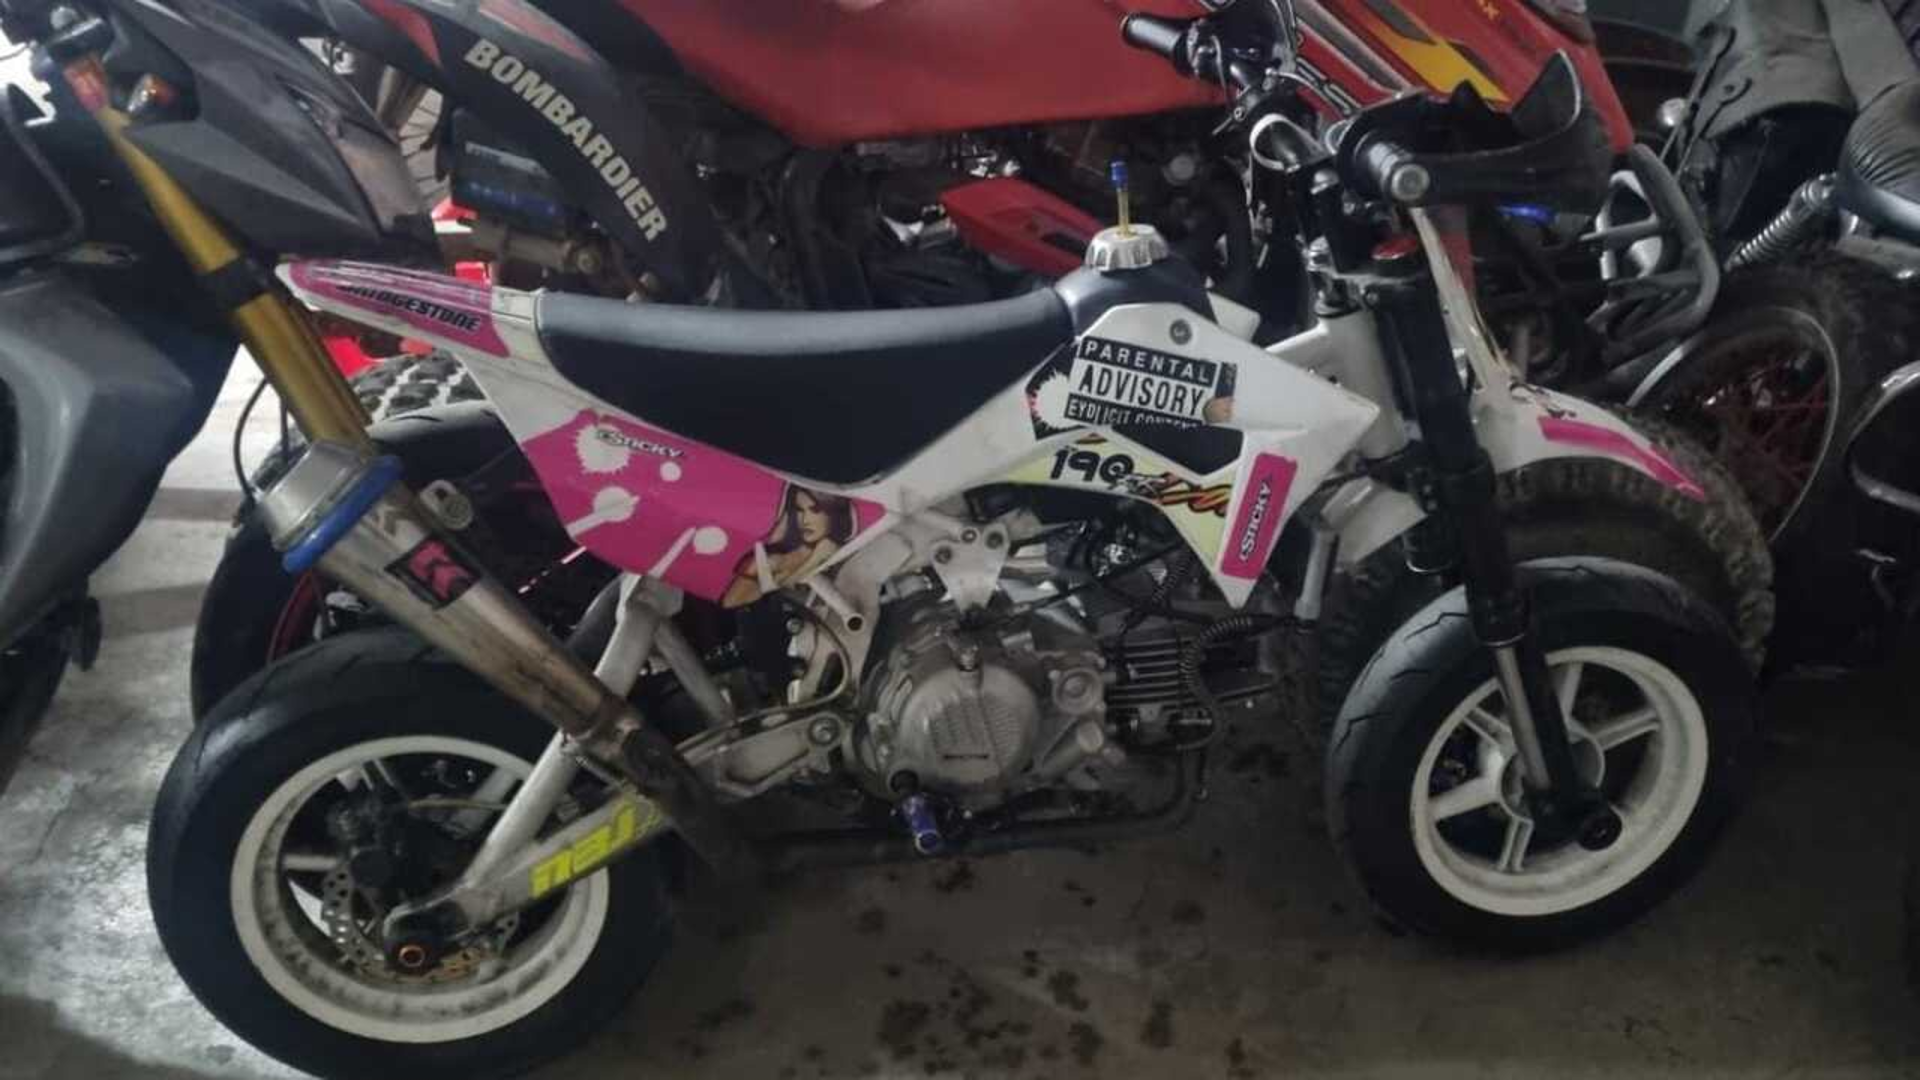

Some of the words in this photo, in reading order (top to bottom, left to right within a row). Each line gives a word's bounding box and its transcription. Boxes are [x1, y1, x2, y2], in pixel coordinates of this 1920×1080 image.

[463, 37, 667, 242] BOMBARDIER
[1078, 364, 1206, 416] ADVISORY
[1085, 340, 1210, 384] PARENTAL
[1240, 478, 1272, 562] STICKY
